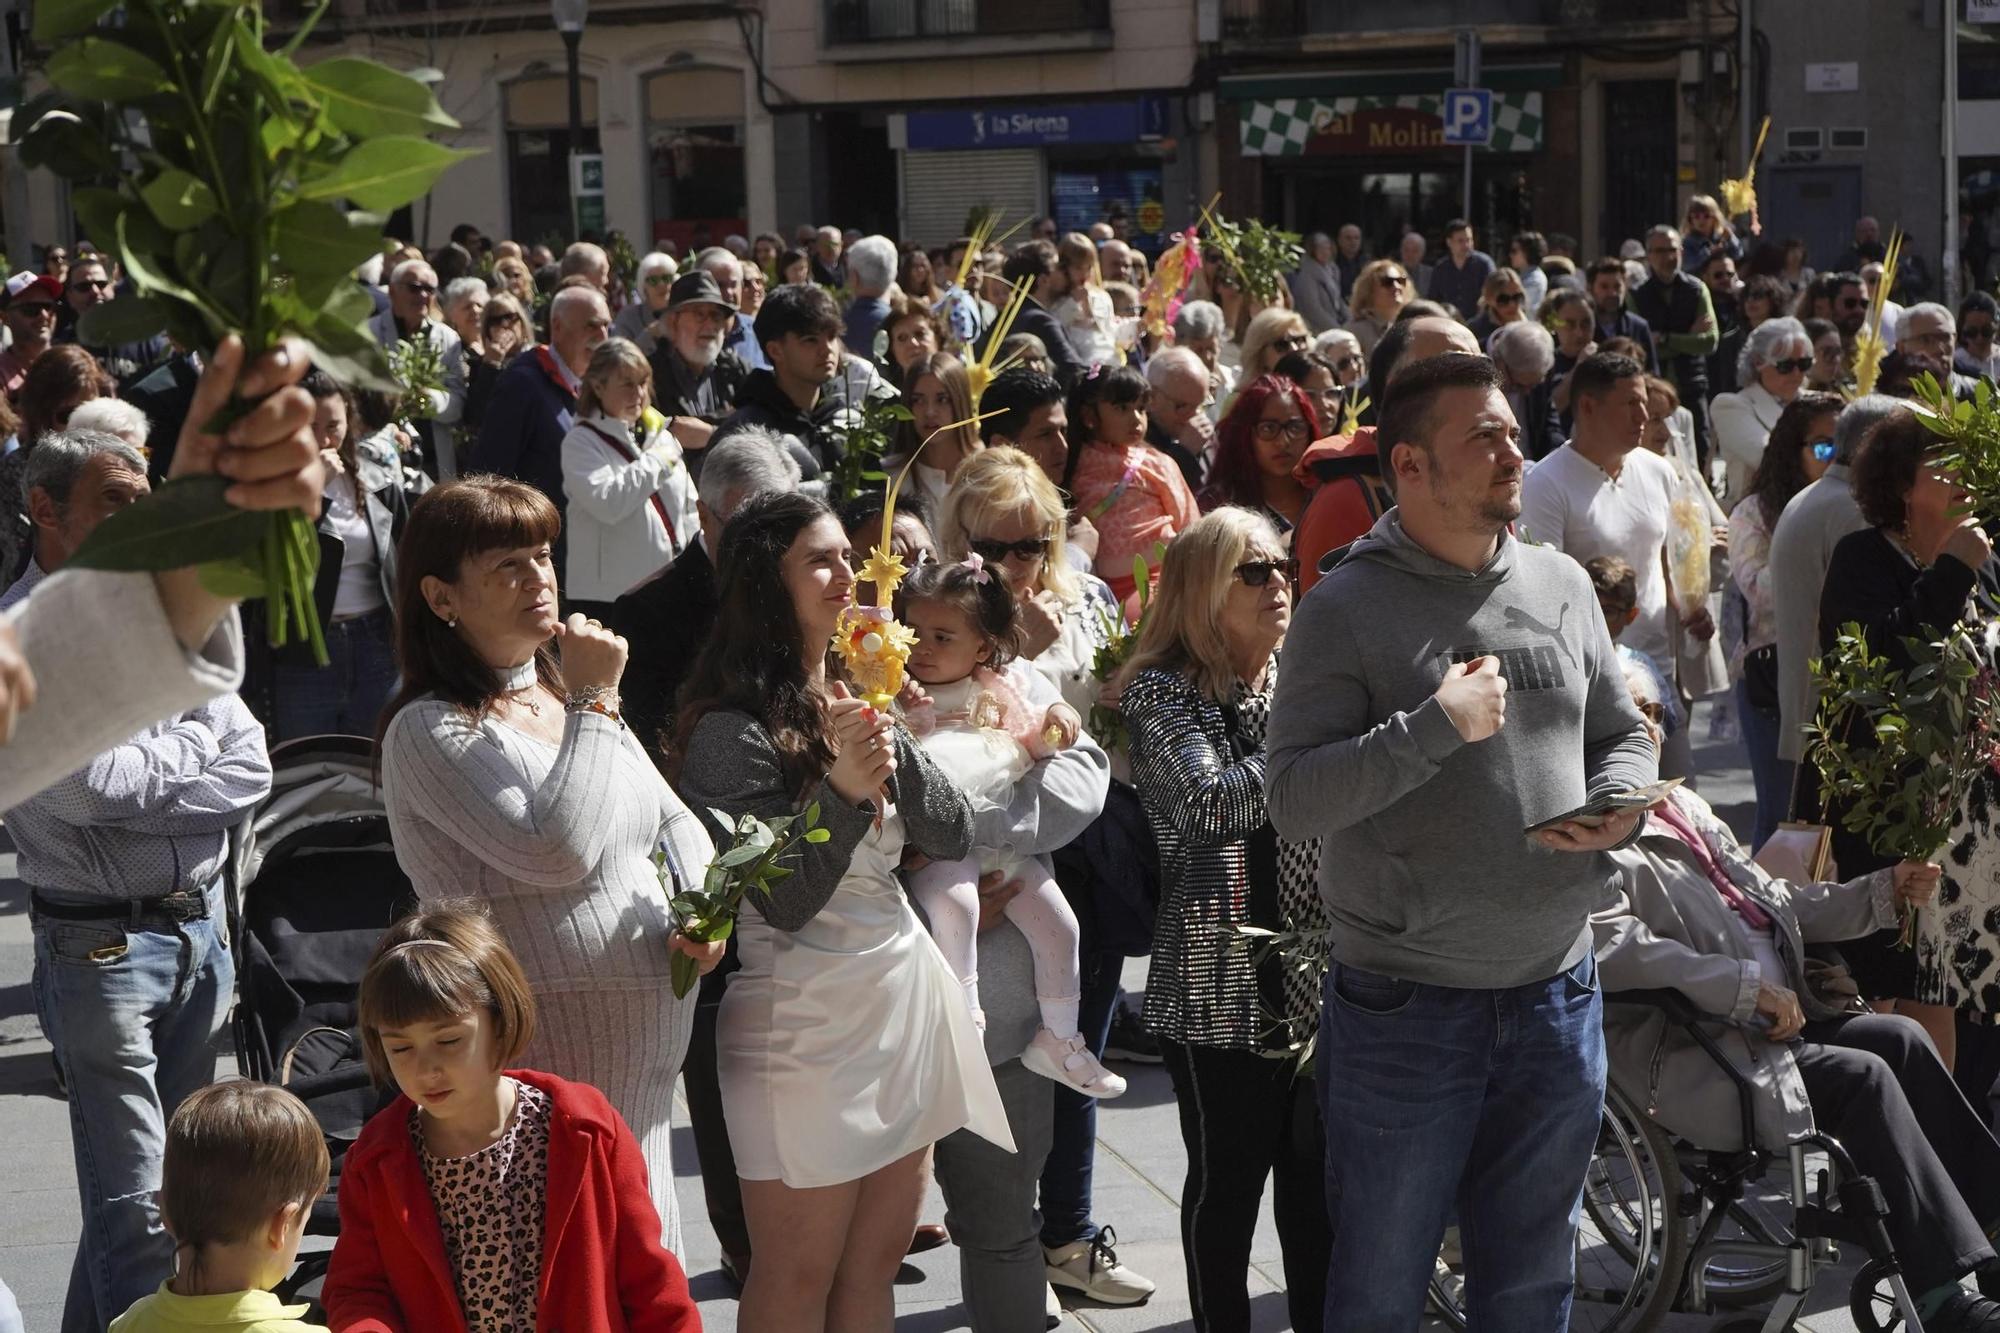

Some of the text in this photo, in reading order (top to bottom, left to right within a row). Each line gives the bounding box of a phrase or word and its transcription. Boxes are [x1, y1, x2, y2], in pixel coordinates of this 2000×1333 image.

[992, 113, 1069, 134] la Sirena
[1316, 110, 1447, 146] Cal Molin
[1454, 95, 1482, 137] P
